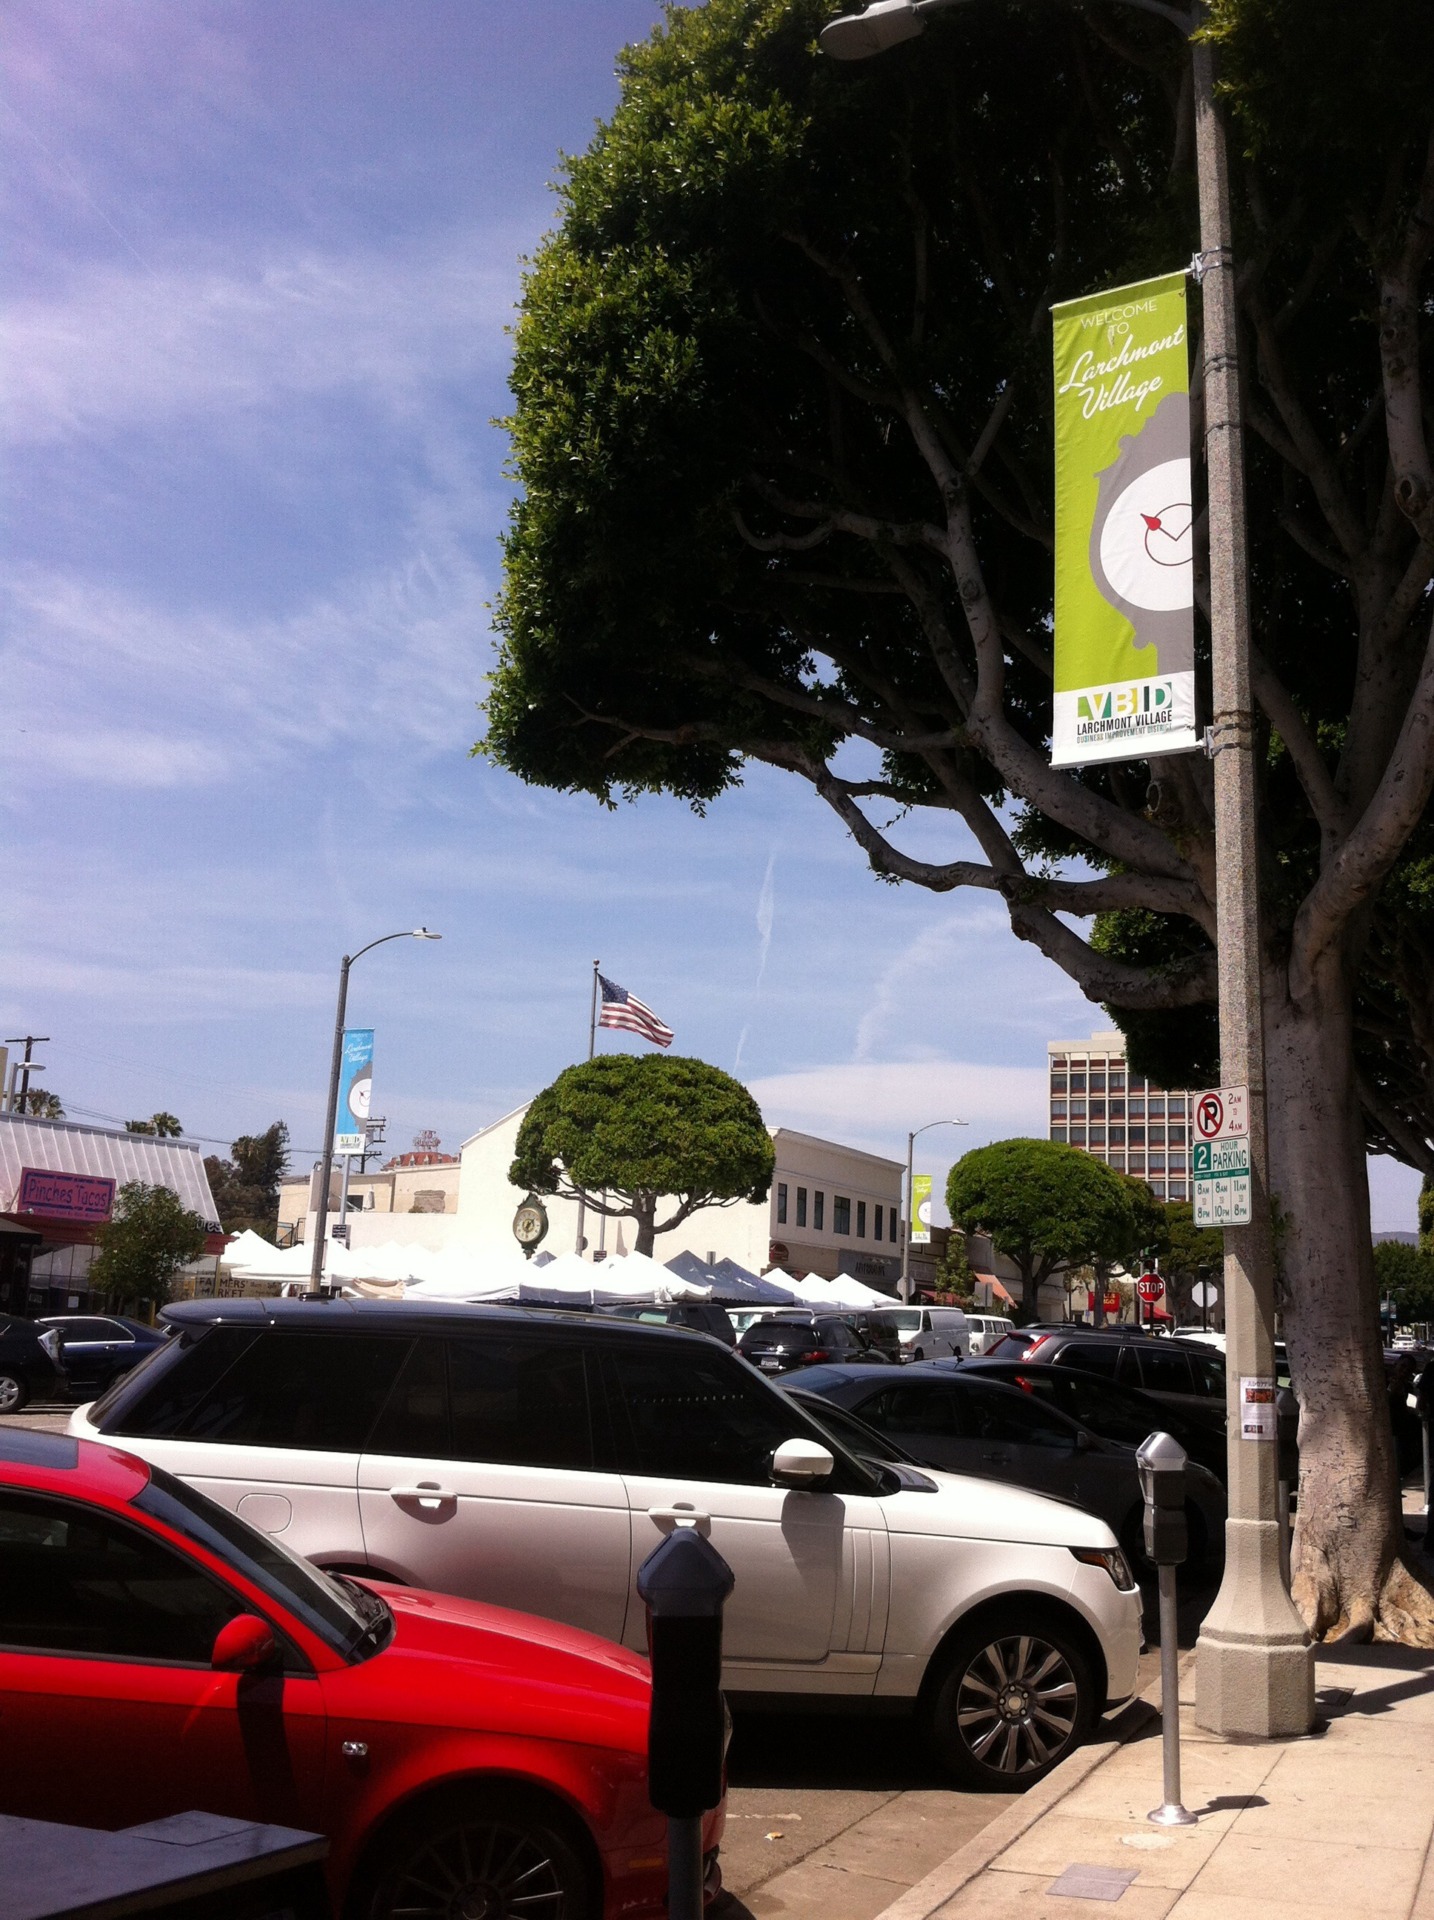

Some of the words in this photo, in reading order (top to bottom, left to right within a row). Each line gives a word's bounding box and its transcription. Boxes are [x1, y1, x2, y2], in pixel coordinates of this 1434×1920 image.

[1081, 299, 1157, 329] WELCOME
[1059, 324, 1185, 393] Larchmont
[1078, 371, 1162, 419] Village
[1077, 716, 1132, 736] LARCHMONT
[1135, 709, 1172, 727] VILLAGE
[1228, 1093, 1242, 1105] 2AM
[1229, 1120, 1243, 1131] 4AM
[1220, 1141, 1238, 1151] HOUR
[1198, 1145, 1208, 1169] 2
[1212, 1150, 1247, 1170] PARKING
[1198, 1183, 1210, 1195] 8AM
[1215, 1181, 1228, 1194] 8AM
[1233, 1180, 1247, 1192] 11AM
[28, 1179, 73, 1204] Pinches
[76, 1185, 107, 1207] Tacos
[1198, 1206, 1210, 1219] 8PM
[1214, 1205, 1230, 1217] 10PM
[1234, 1204, 1247, 1216] 8PM
[199, 1278, 249, 1289] FAMERS'
[1139, 1282, 1164, 1293] STOP
